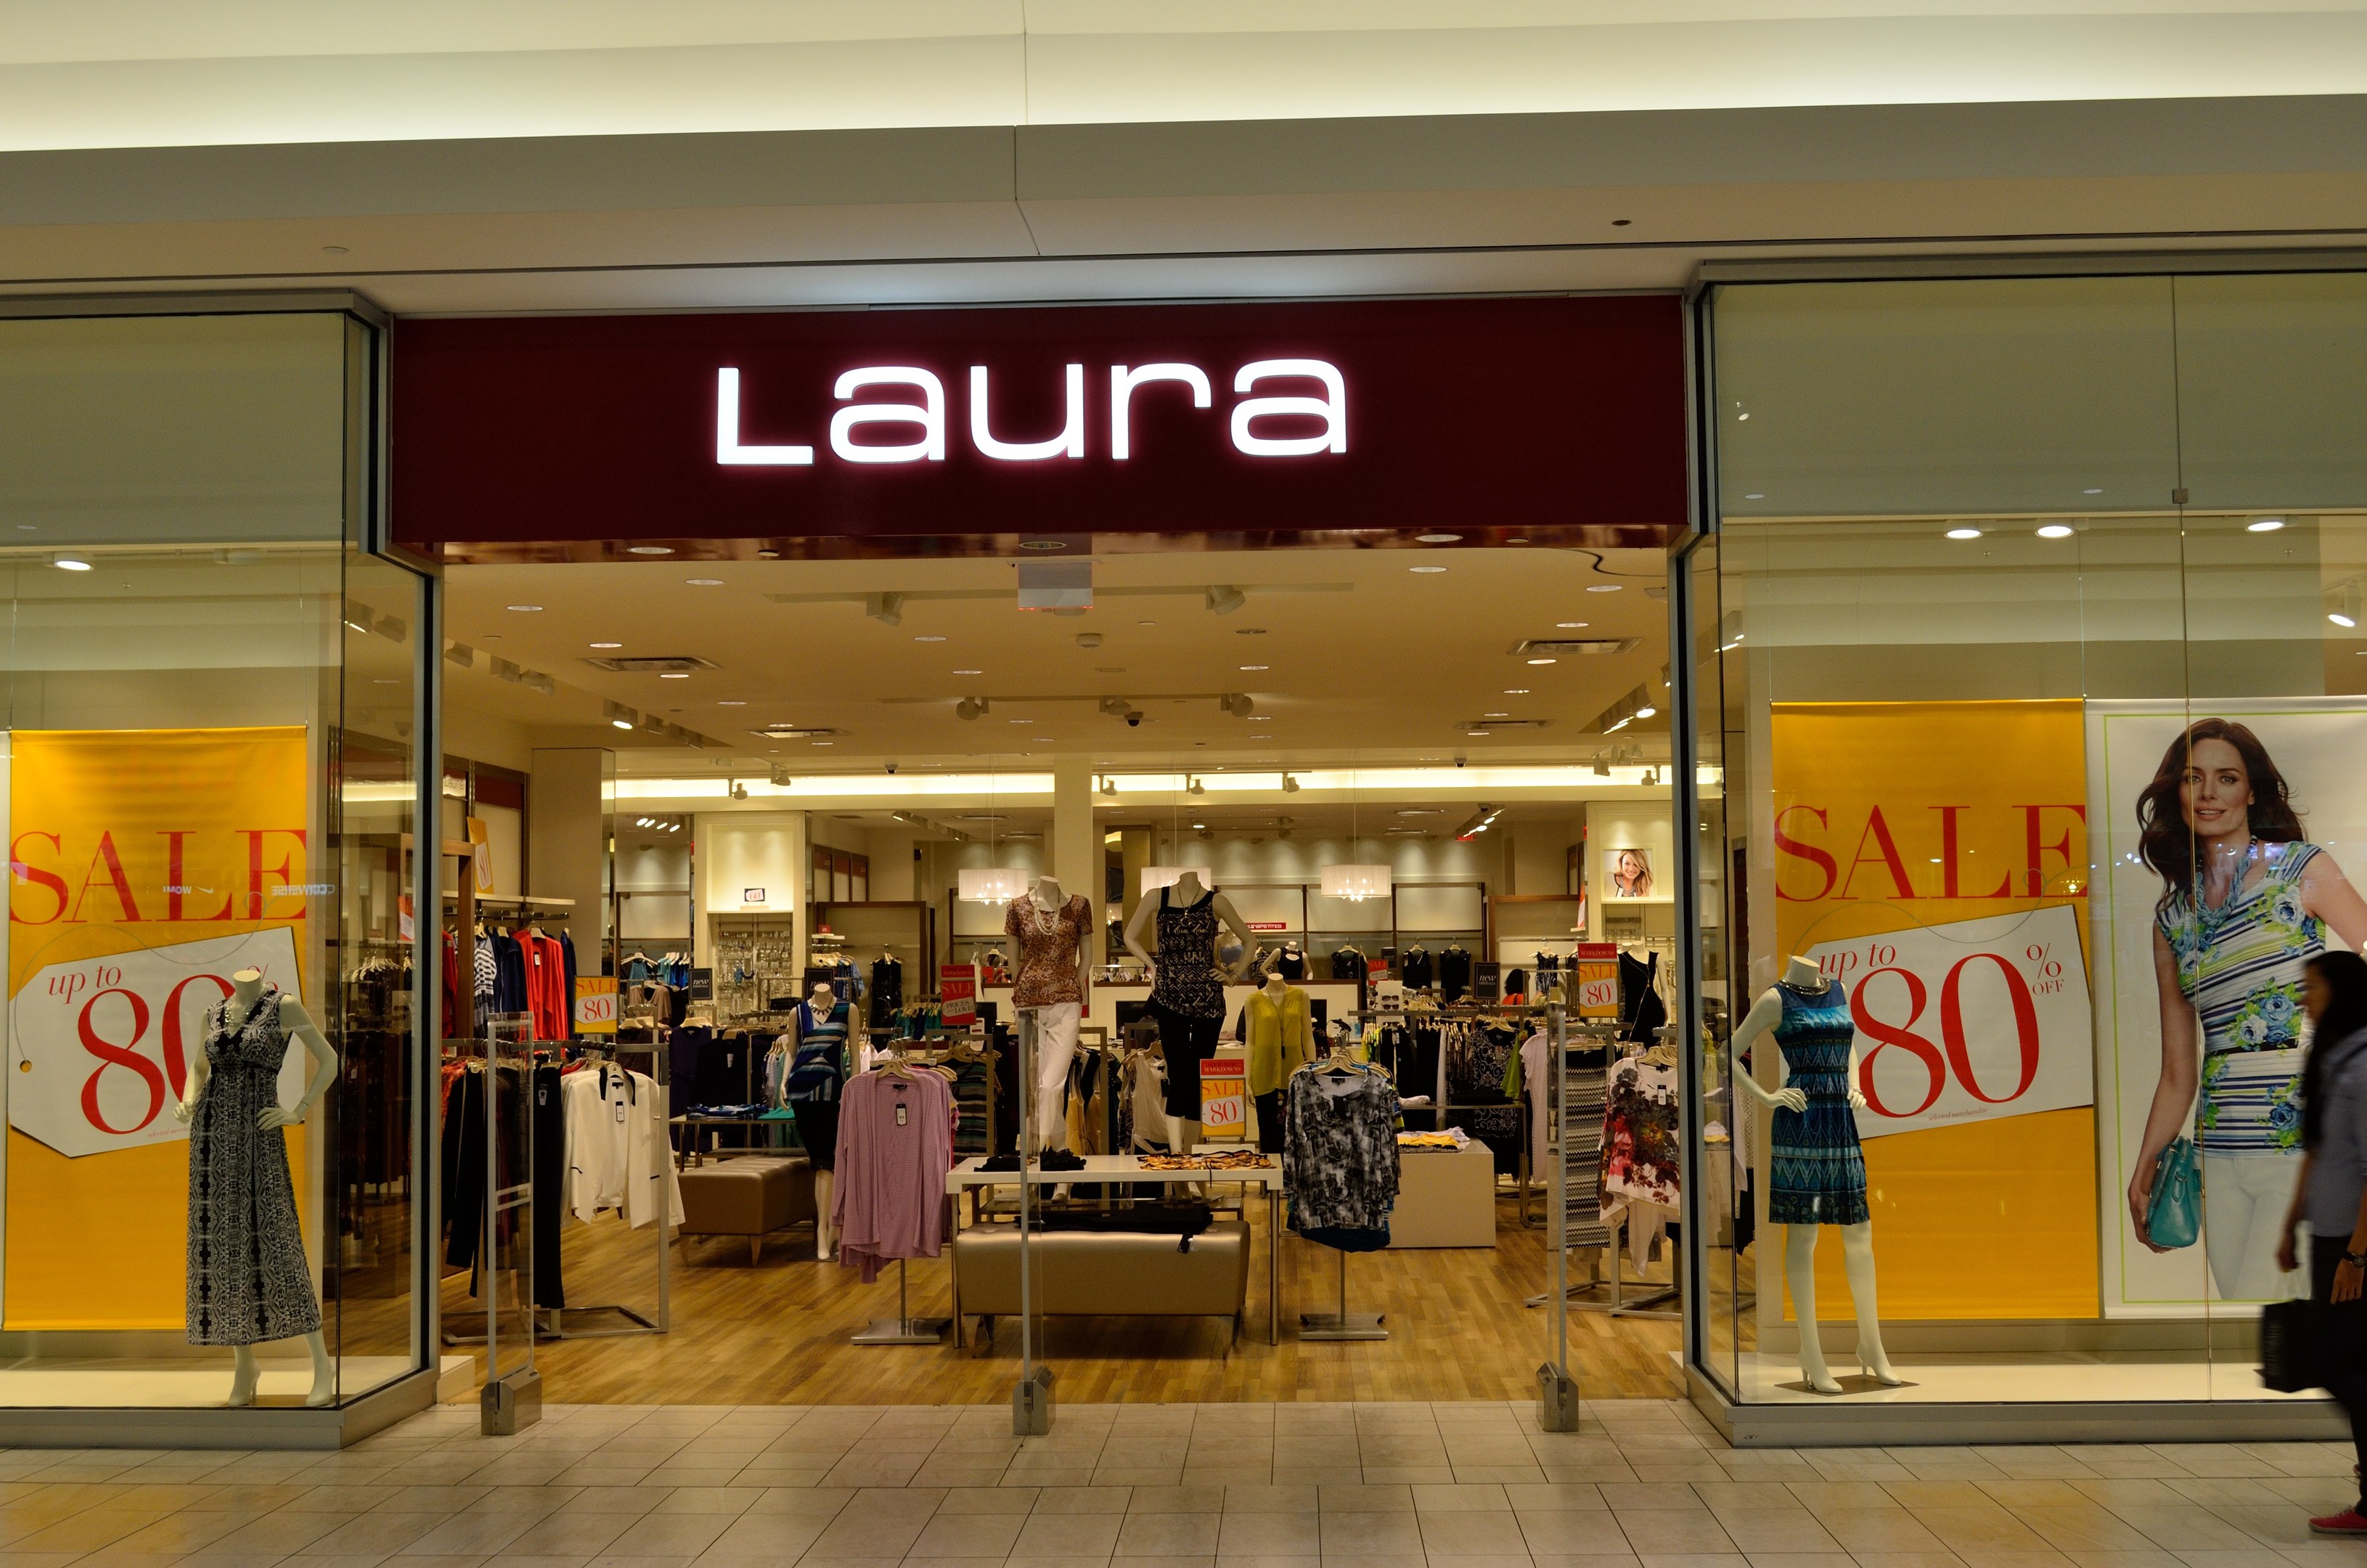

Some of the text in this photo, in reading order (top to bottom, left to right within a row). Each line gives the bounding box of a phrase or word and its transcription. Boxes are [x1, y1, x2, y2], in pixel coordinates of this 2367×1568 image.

[716, 359, 1347, 465] Laura
[1774, 804, 2088, 902] SALE
[9, 829, 306, 926] SALE
[1579, 965, 1617, 979] SALE
[1818, 944, 1896, 982] up to
[48, 965, 122, 1005] up to
[576, 979, 618, 993] SALE
[942, 981, 974, 995] SALE
[1587, 982, 1611, 1005] 80
[2032, 979, 2064, 995] OFF
[584, 997, 611, 1021] 80
[1850, 953, 2040, 1119] 80
[1201, 1081, 1245, 1096] SALE
[1210, 1100, 1238, 1124] 80
